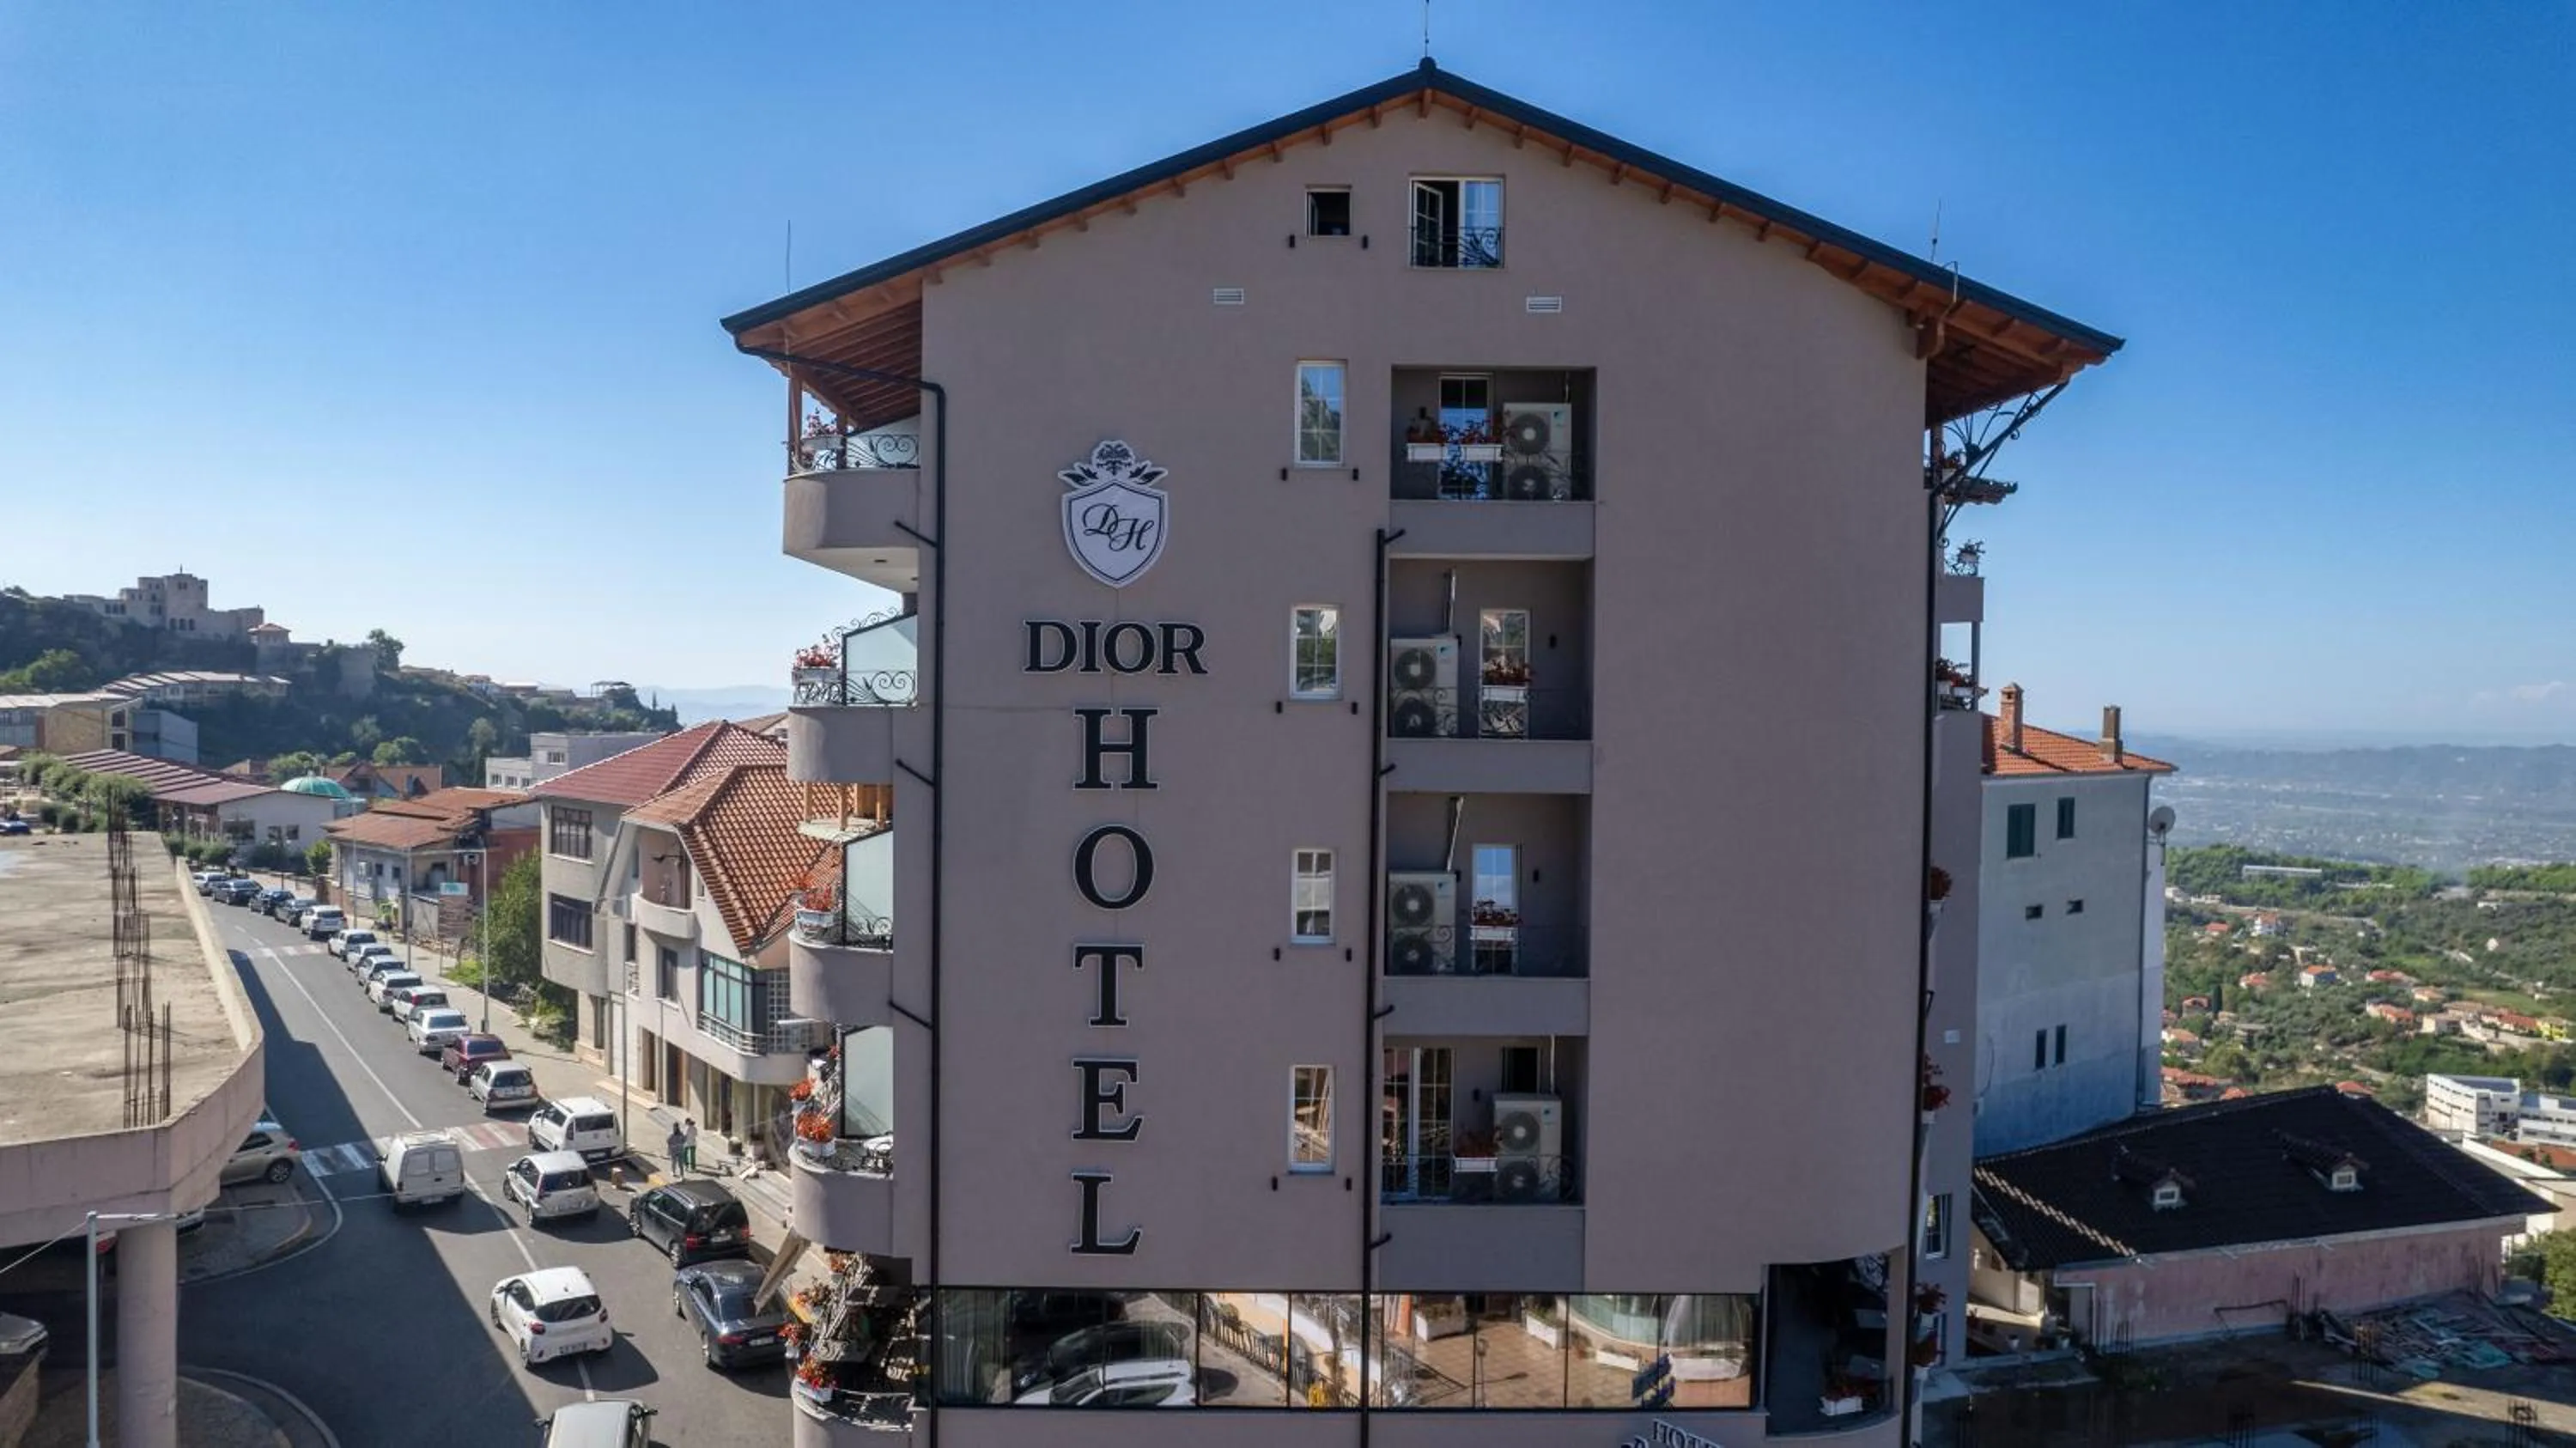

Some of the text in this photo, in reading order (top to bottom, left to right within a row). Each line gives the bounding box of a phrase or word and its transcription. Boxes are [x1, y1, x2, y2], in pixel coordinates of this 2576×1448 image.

[1024, 620, 1208, 674] DIOR
[1071, 708, 1159, 1256] HOTEL
[1652, 1419, 1722, 1448] HOT
